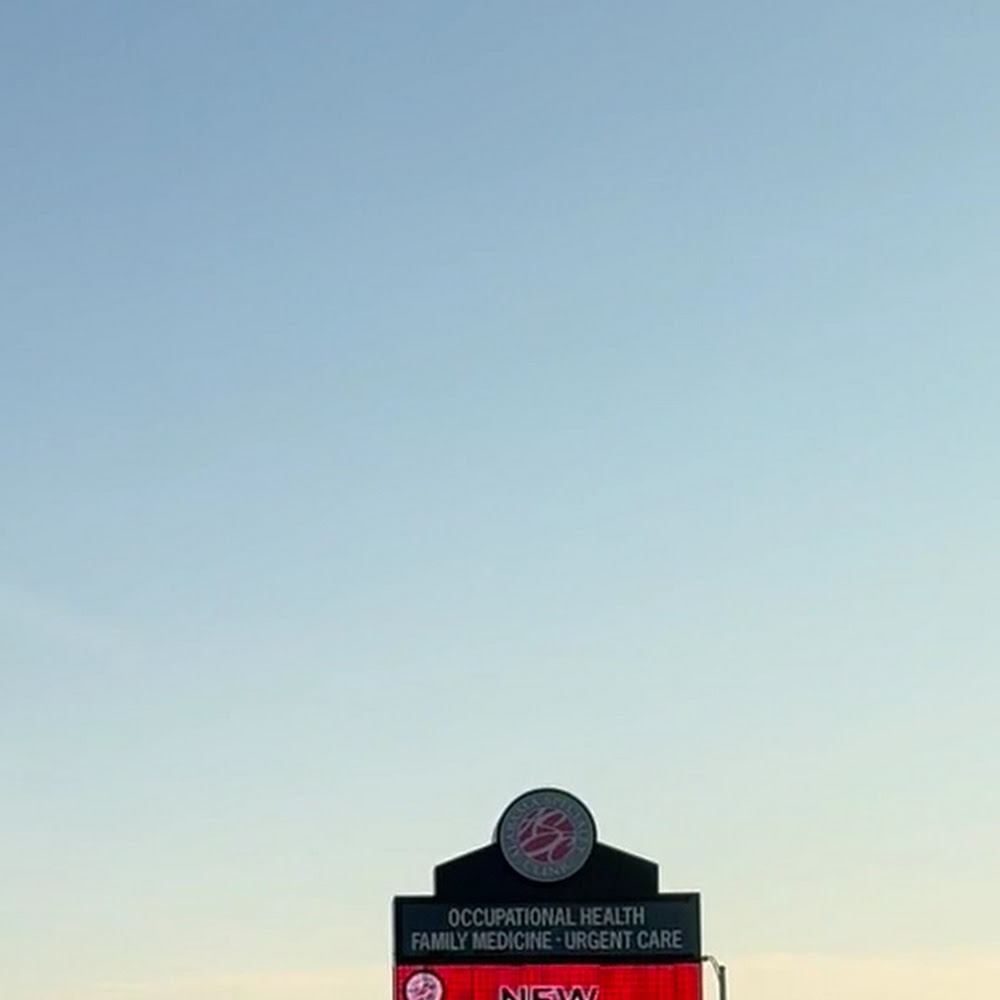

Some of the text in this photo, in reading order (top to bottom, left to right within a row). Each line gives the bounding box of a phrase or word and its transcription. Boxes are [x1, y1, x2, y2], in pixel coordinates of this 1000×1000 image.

[448, 906, 645, 927] OCCUPATIONAL HEALTH
[411, 930, 683, 950] FAMILY MEDICINE URGENT CARE
